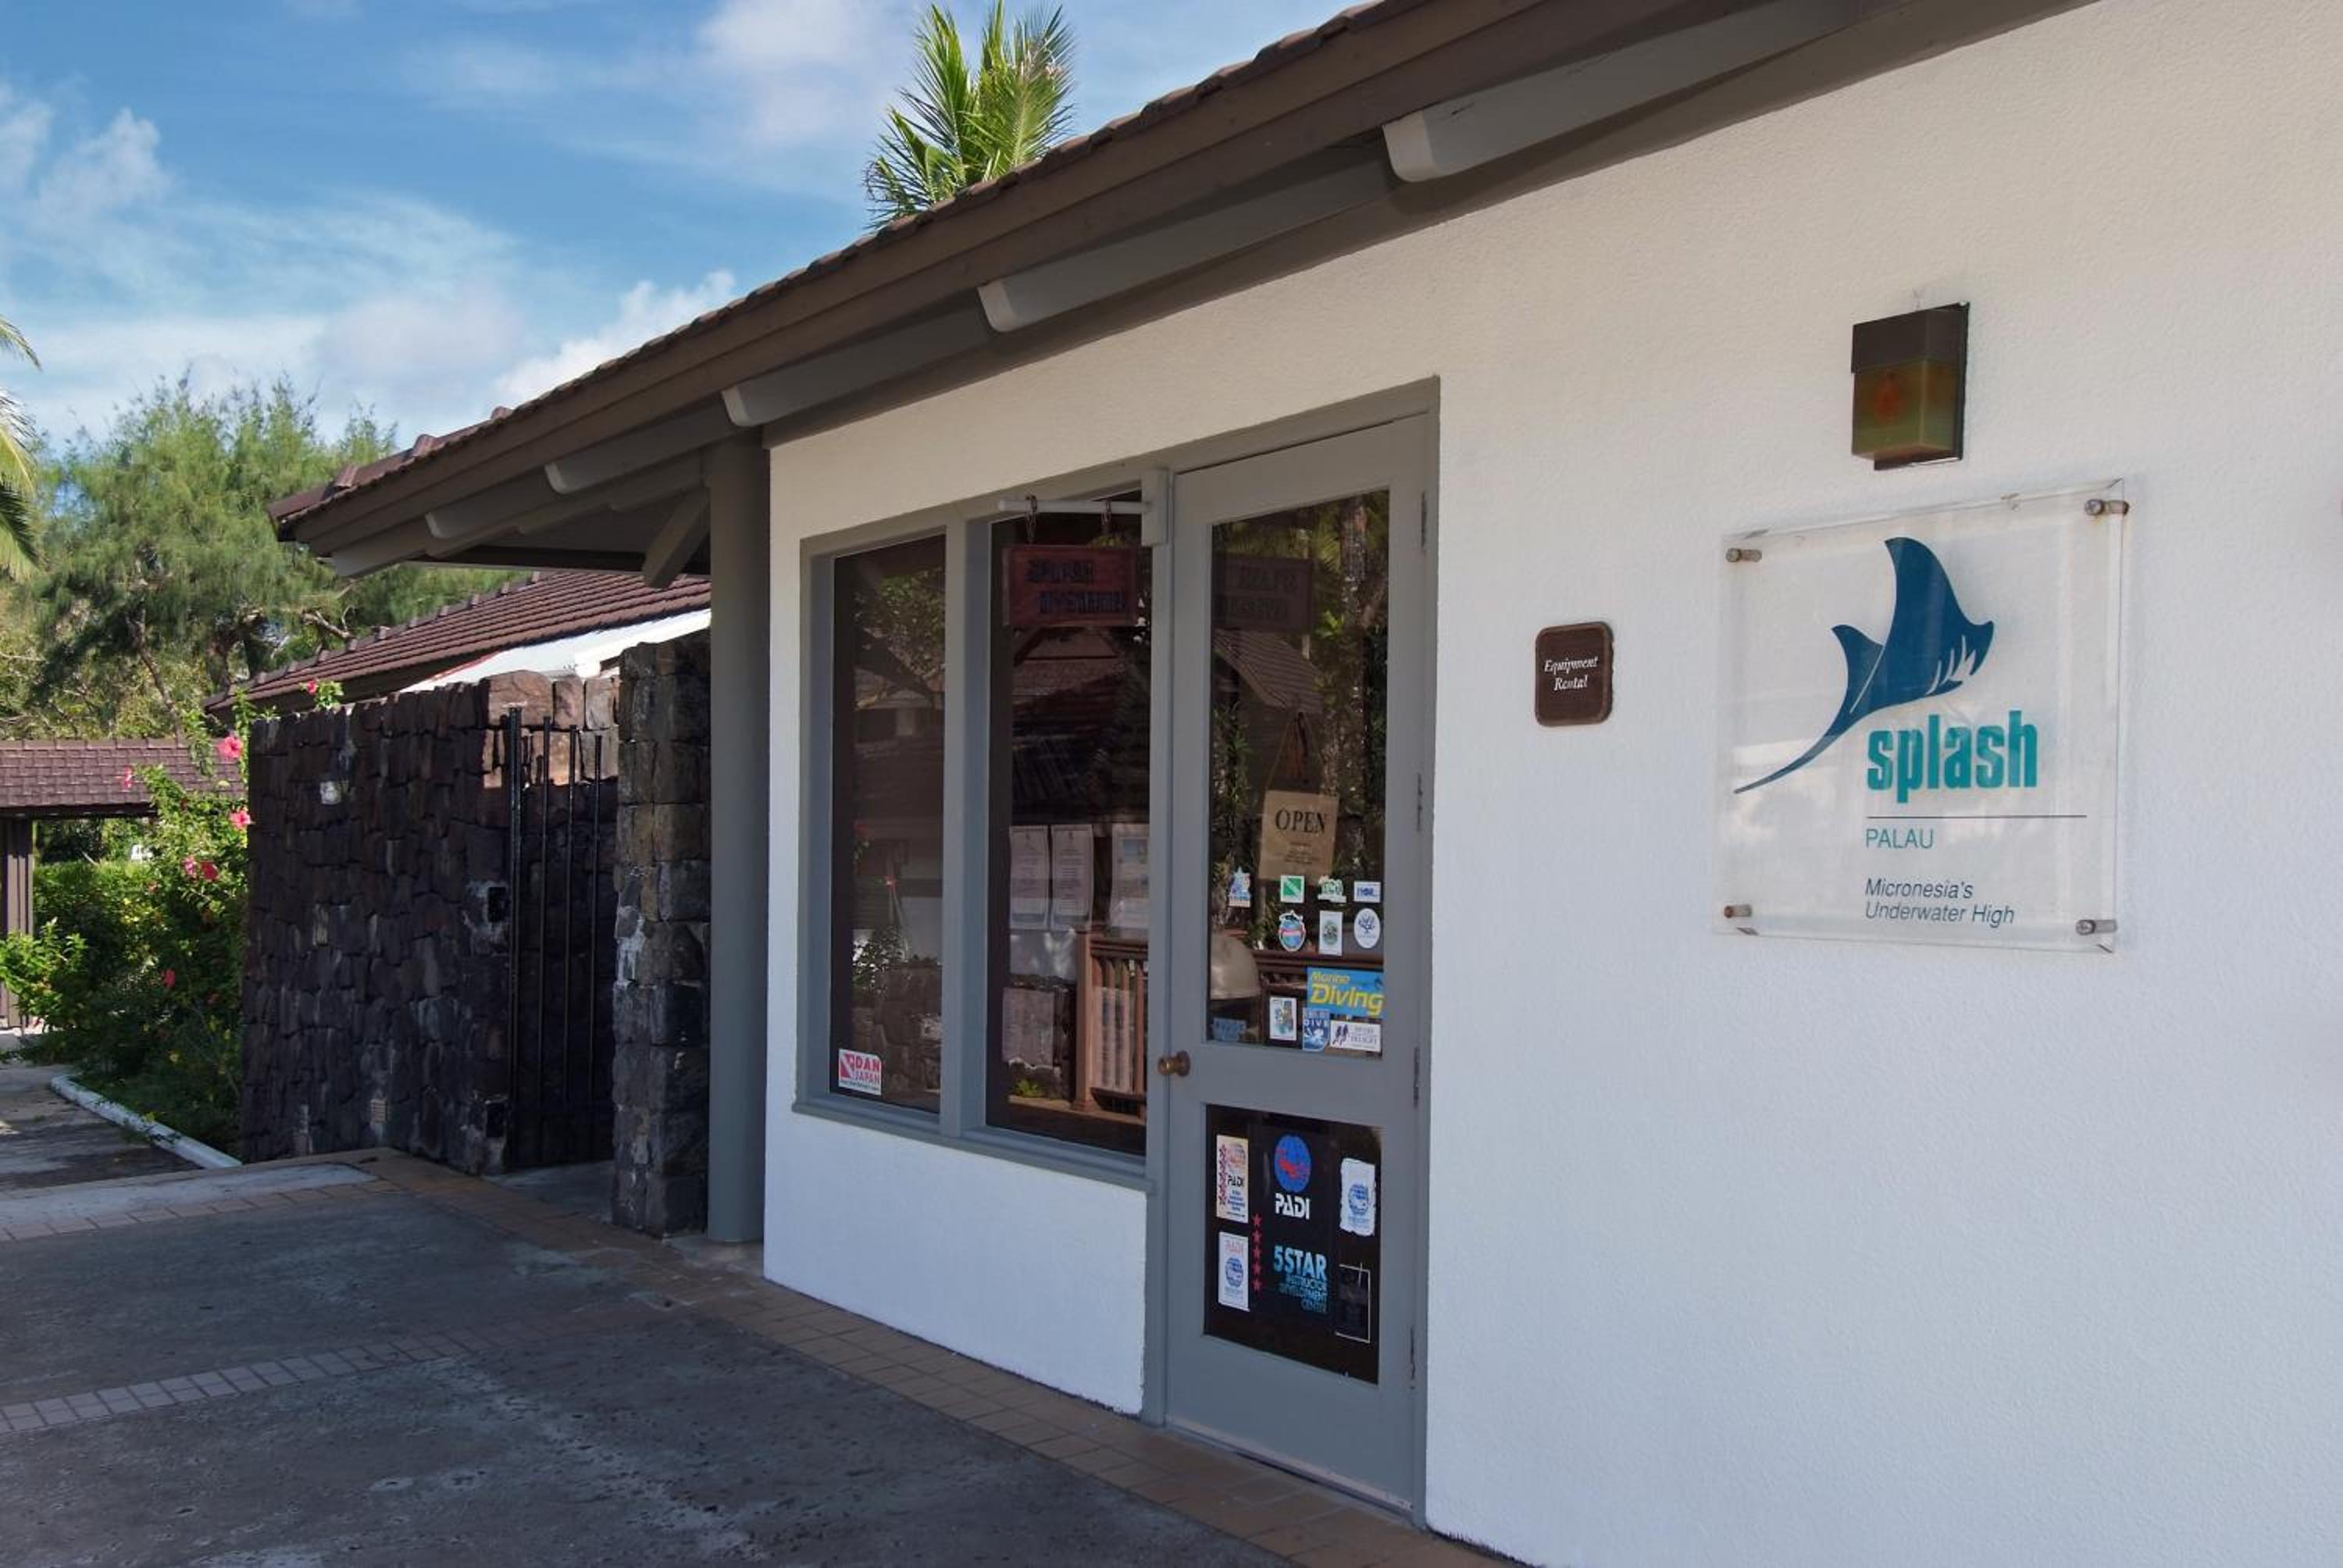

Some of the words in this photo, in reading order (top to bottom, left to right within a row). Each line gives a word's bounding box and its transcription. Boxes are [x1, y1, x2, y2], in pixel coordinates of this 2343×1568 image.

[1544, 655, 1599, 675] Equipment
[1553, 675, 1588, 691] Rental
[1867, 710, 2038, 804] splash
[1275, 807, 1327, 835] OPEN
[1866, 828, 1934, 849] PALAU
[1865, 878, 1974, 899] Micronesia's
[1866, 902, 1966, 922] Underwater
[1972, 904, 2014, 928] High
[1310, 983, 1384, 1017] Diving
[855, 1055, 879, 1072] DAN
[854, 1071, 879, 1084] JAPAN
[1275, 1192, 1311, 1220] PADI
